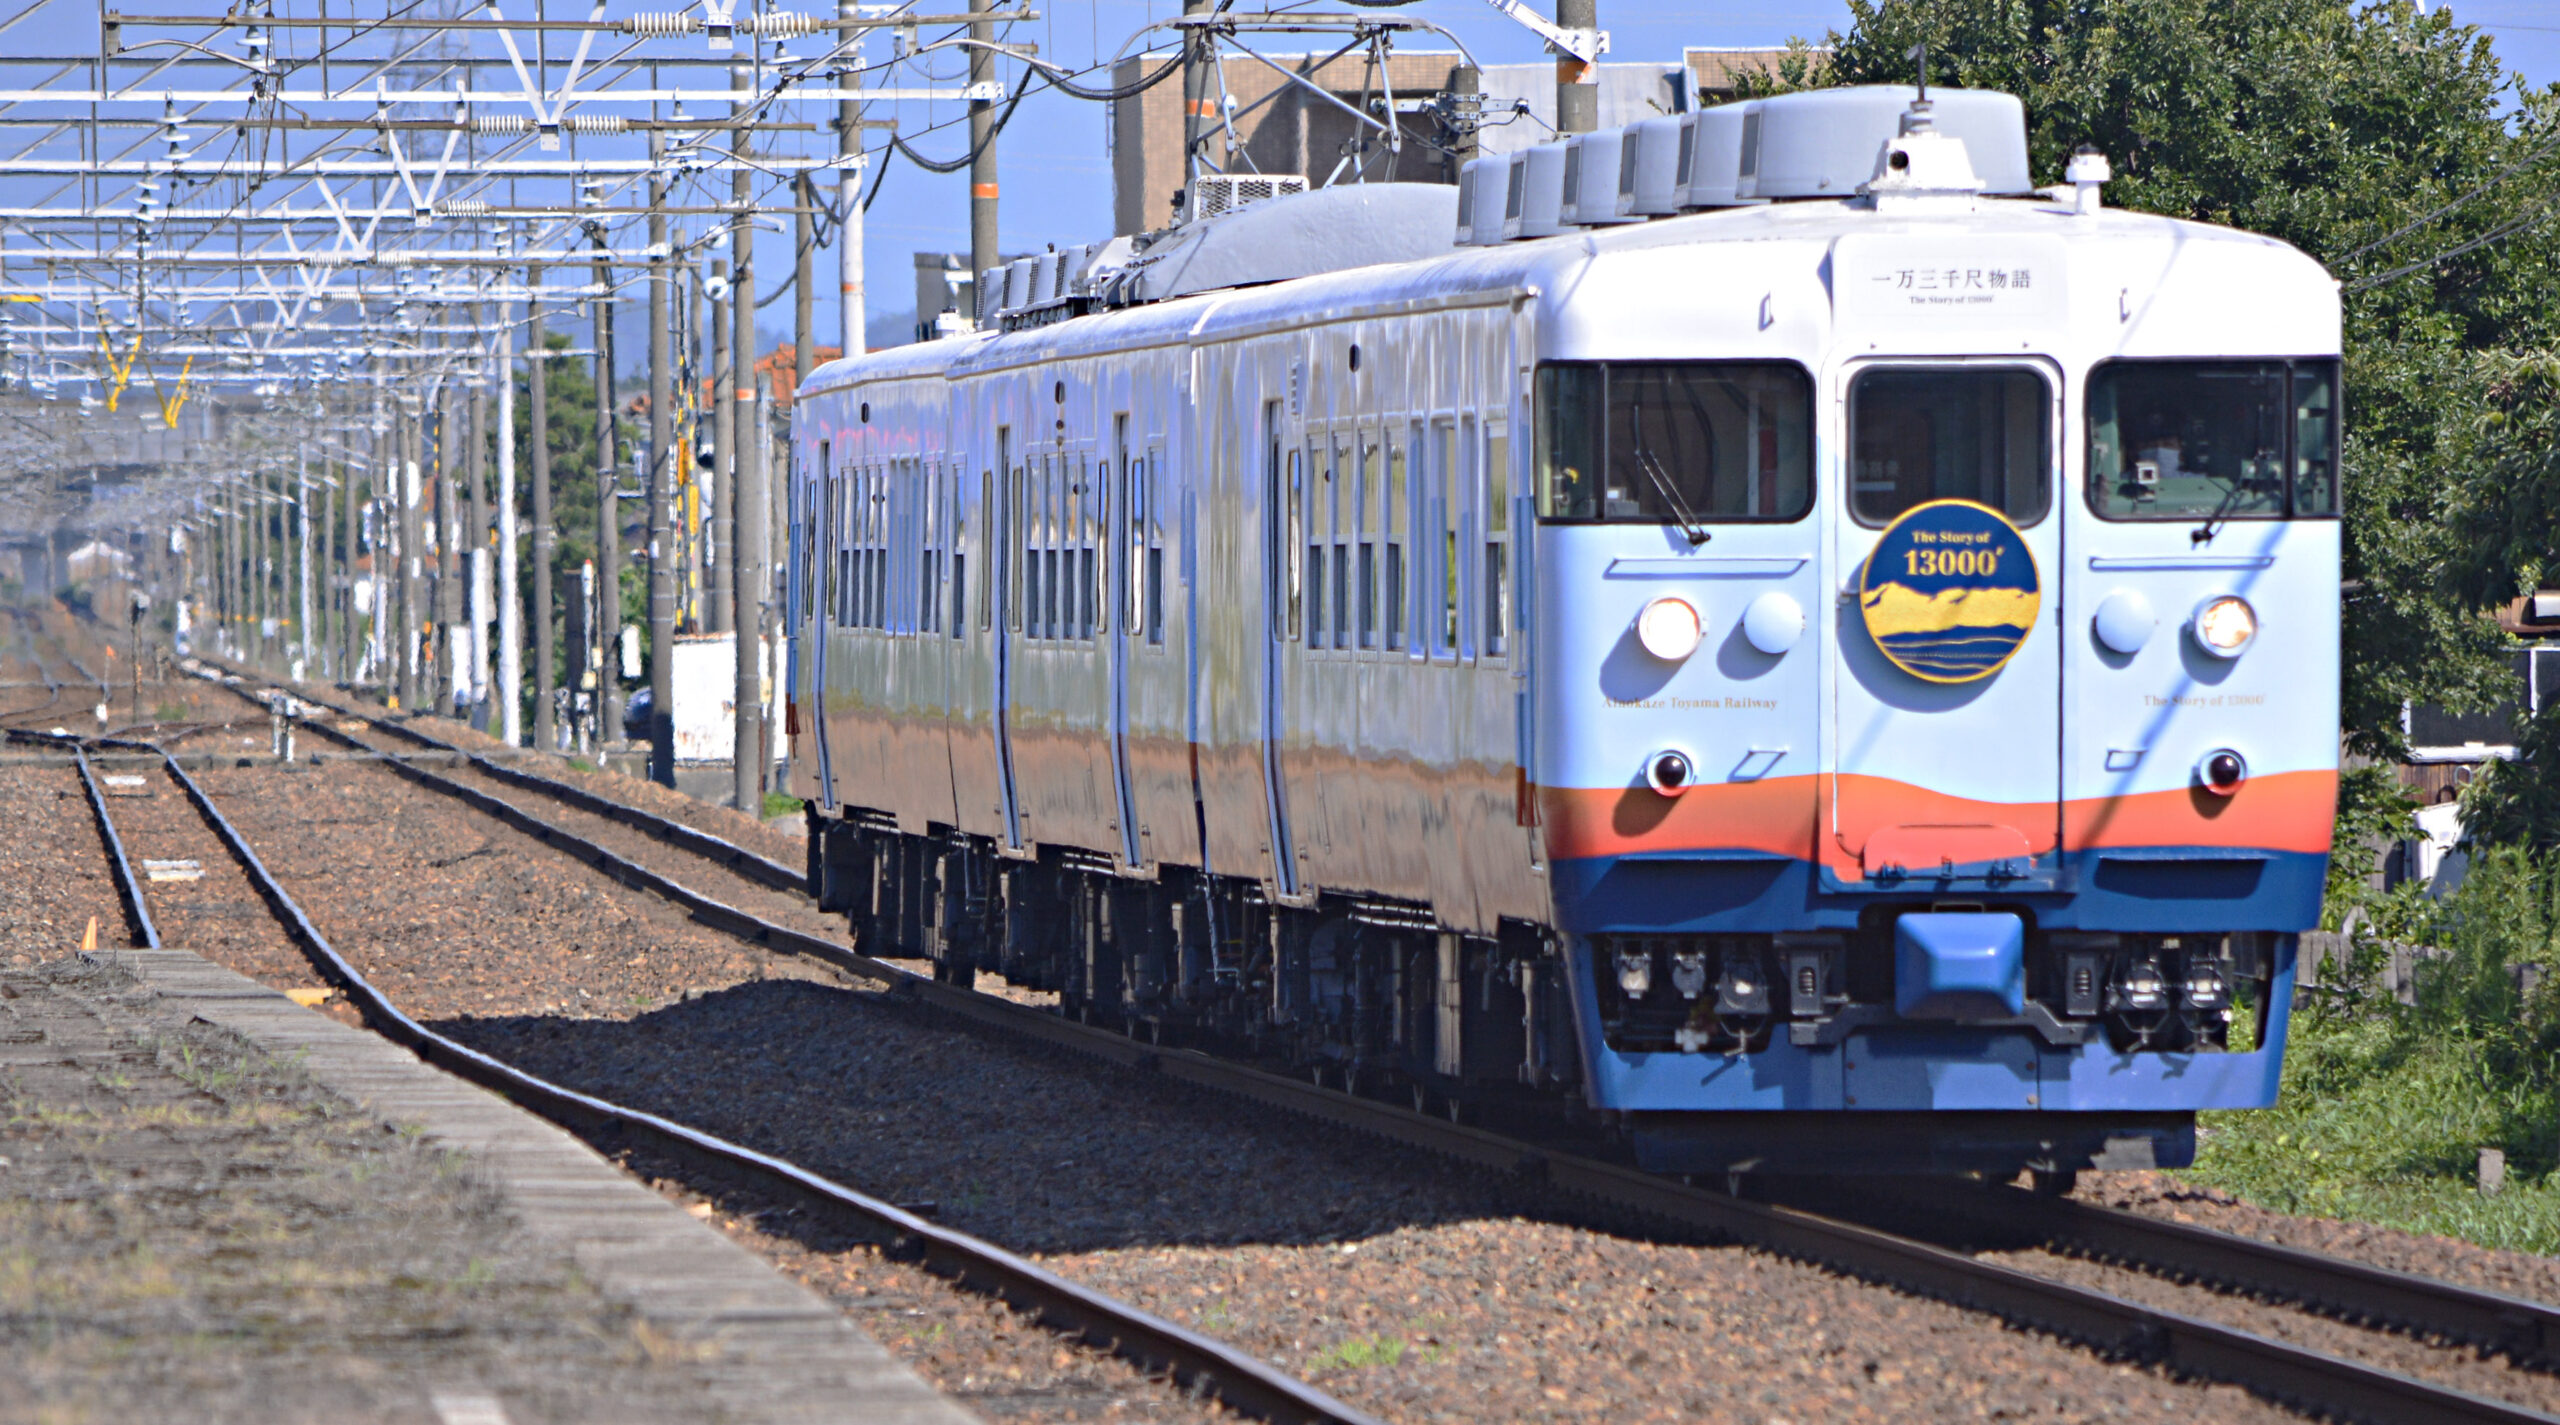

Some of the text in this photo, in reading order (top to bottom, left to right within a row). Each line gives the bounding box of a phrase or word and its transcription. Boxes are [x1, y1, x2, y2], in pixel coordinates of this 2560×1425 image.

[1871, 269, 2031, 289] 一万三千尺物語
[1909, 295, 1926, 304] The
[1928, 295, 1952, 306] Story
[1955, 295, 1965, 304] of
[1912, 530, 1991, 545] The Story of
[1671, 697, 1721, 711] Toyama
[1724, 697, 1778, 711] Railway
[2144, 695, 2168, 706] The
[2171, 695, 2206, 709] Story
[2210, 695, 2224, 706] of
